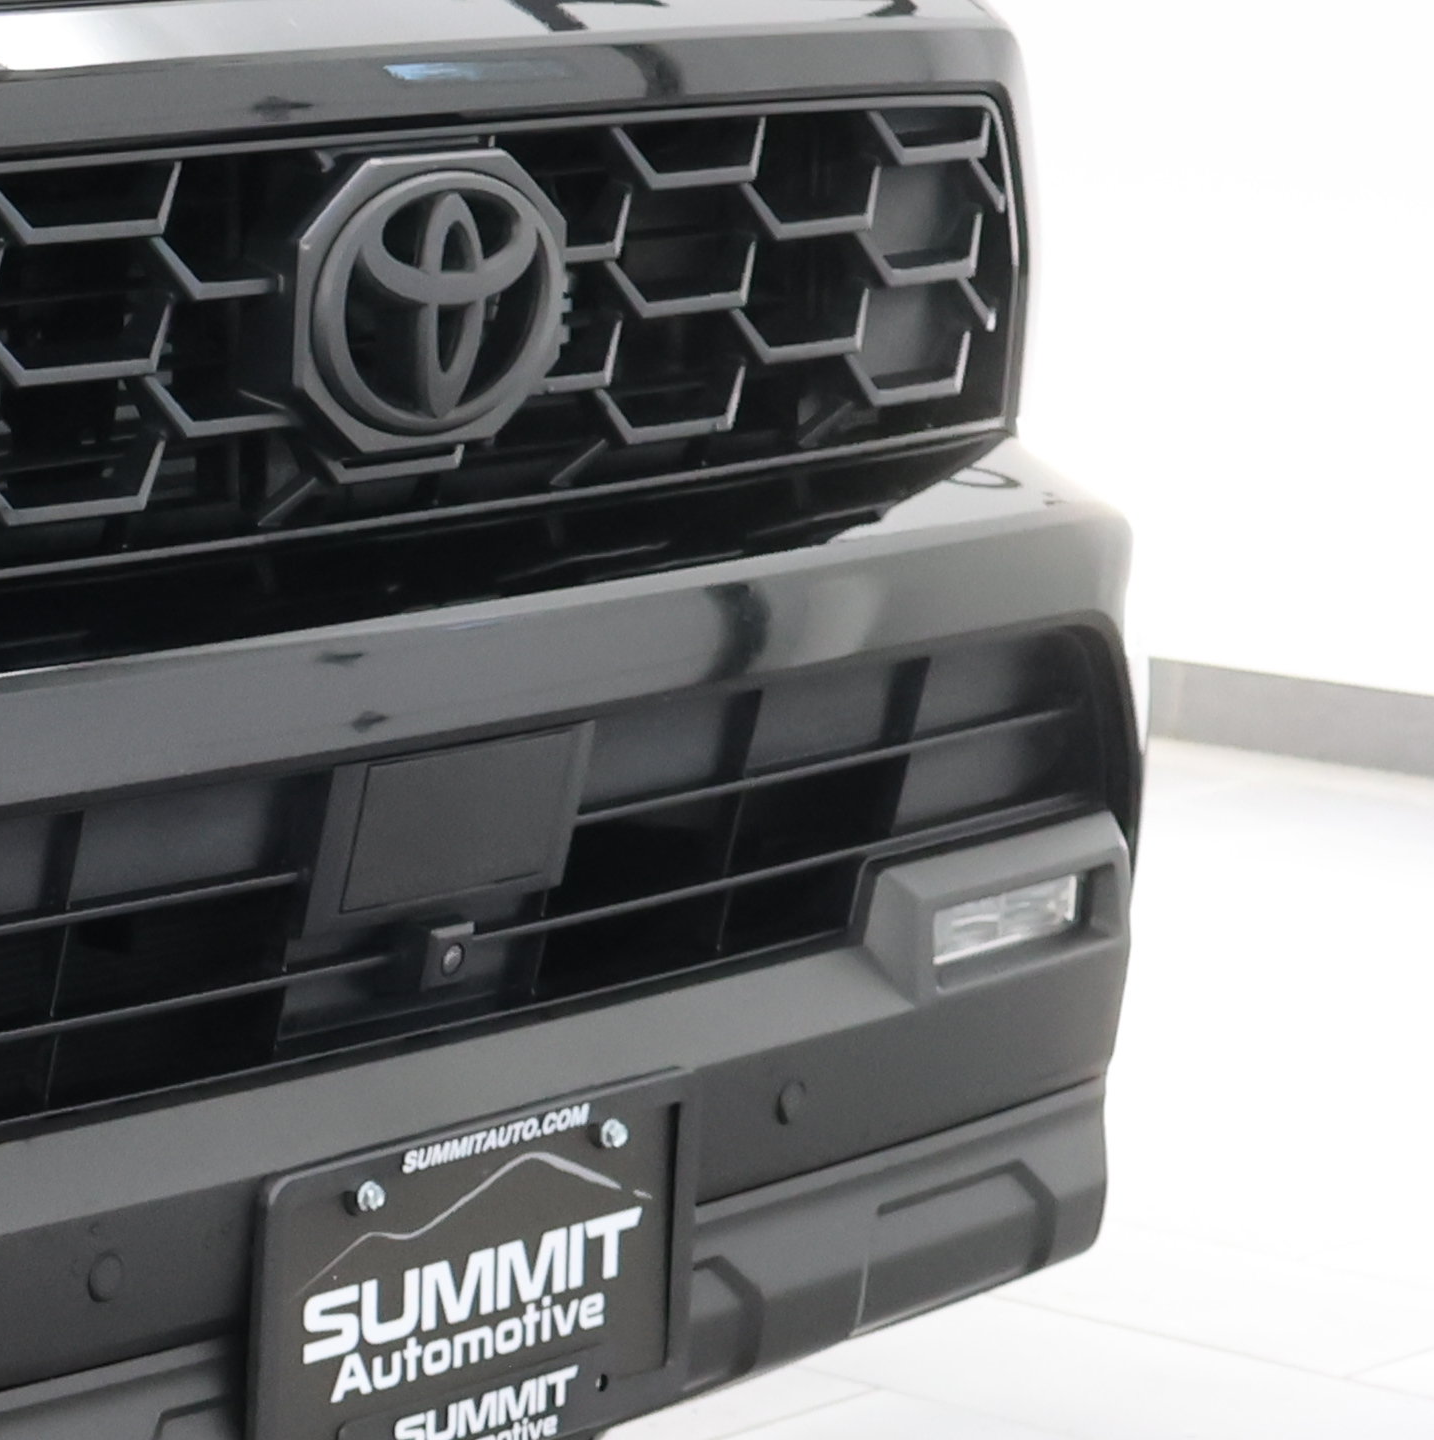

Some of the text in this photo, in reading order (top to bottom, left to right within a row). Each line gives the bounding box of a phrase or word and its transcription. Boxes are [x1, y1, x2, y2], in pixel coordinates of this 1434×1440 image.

[402, 1102, 591, 1174] SUMMITAUTO.COM
[302, 1206, 644, 1366] SUMMIT
[330, 1291, 606, 1405] Automotive
